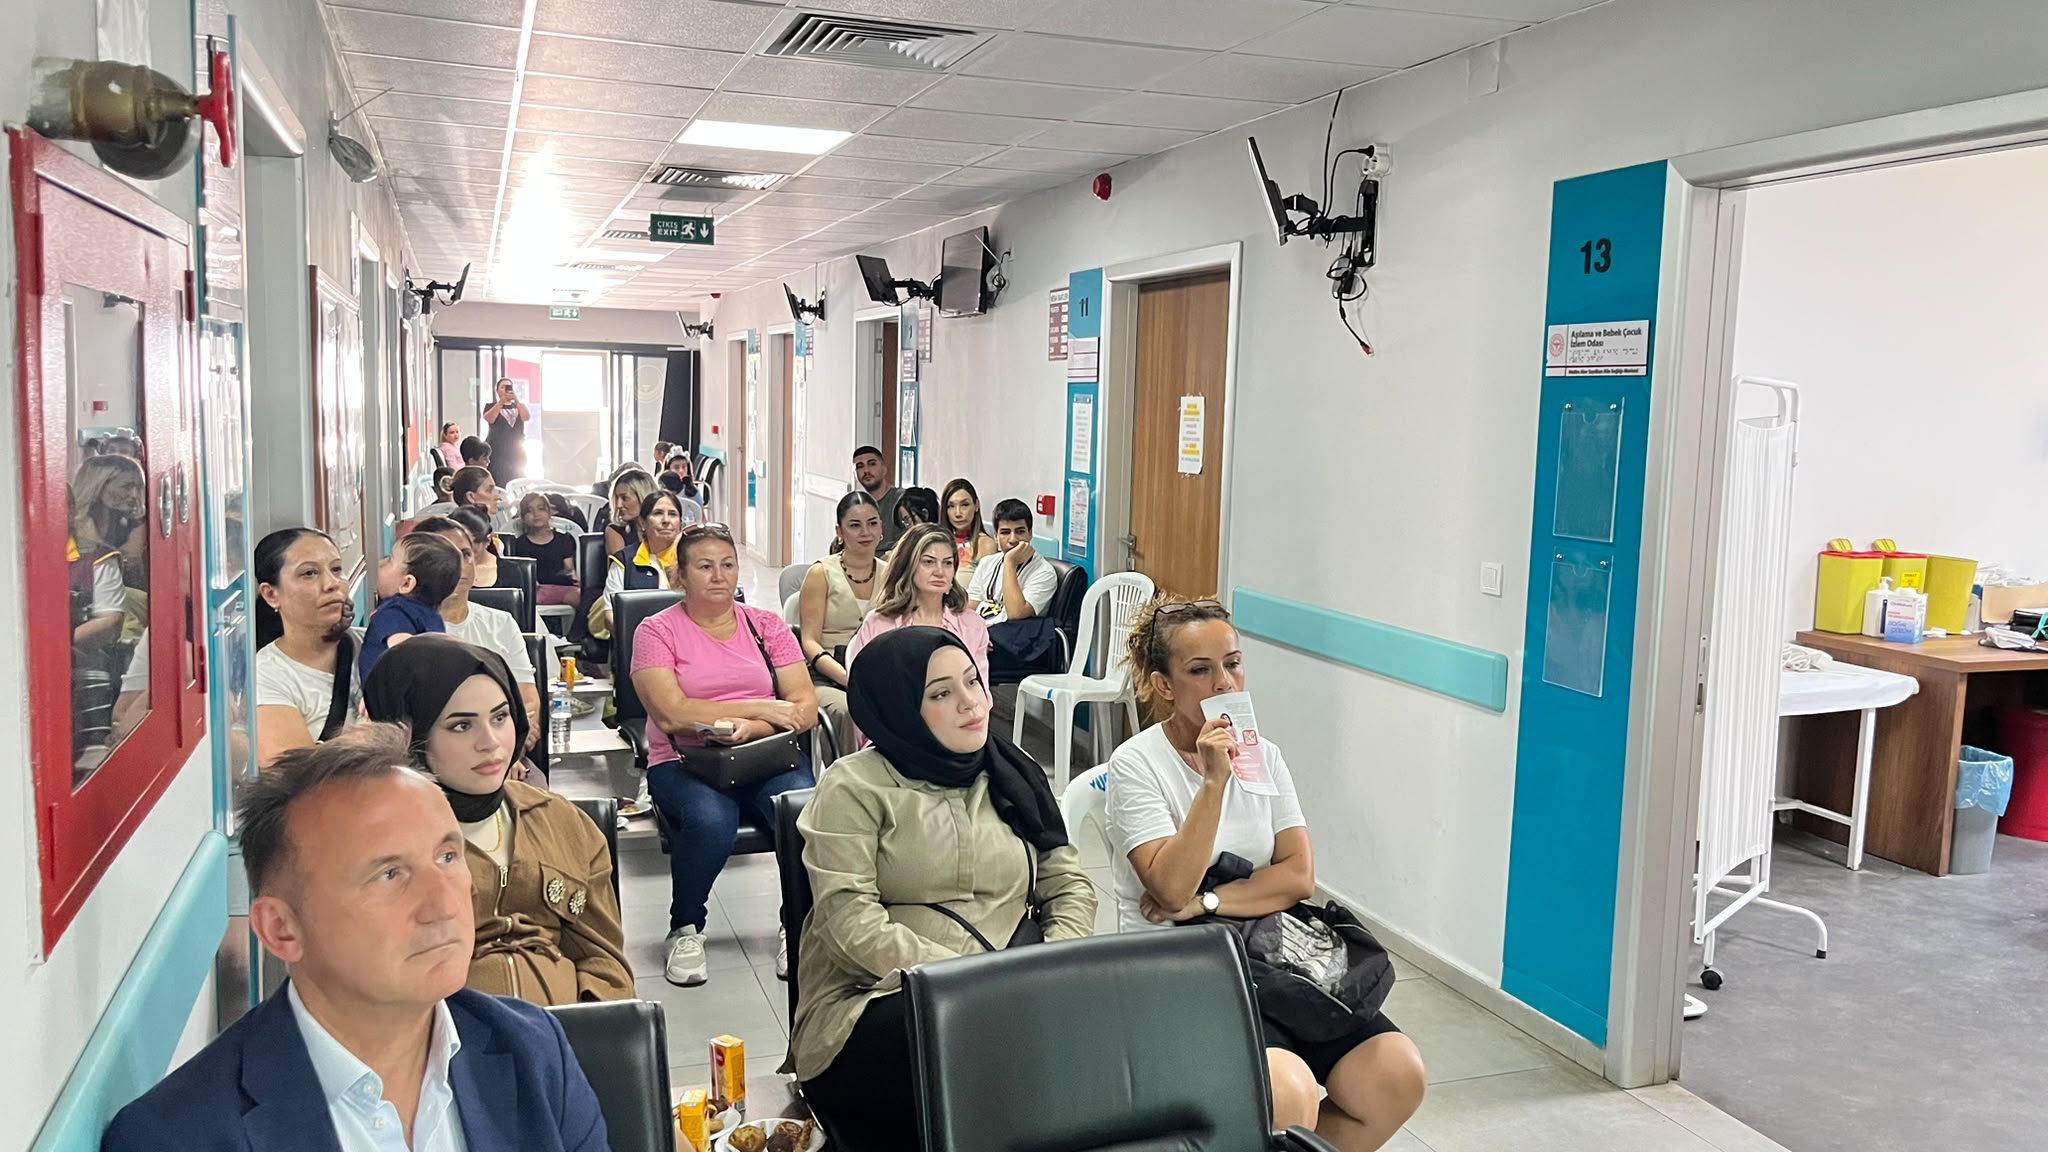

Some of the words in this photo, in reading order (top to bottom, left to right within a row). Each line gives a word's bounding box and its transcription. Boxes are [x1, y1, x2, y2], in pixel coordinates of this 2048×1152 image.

[1580, 238, 1612, 275] 13
[1079, 297, 1089, 317] 11
[1571, 330, 1594, 339] Aşılama
[1603, 328, 1622, 337] Bebek
[1622, 328, 1642, 338] Çocuk
[1570, 339, 1586, 348] İzlem
[1587, 339, 1604, 347] Odası
